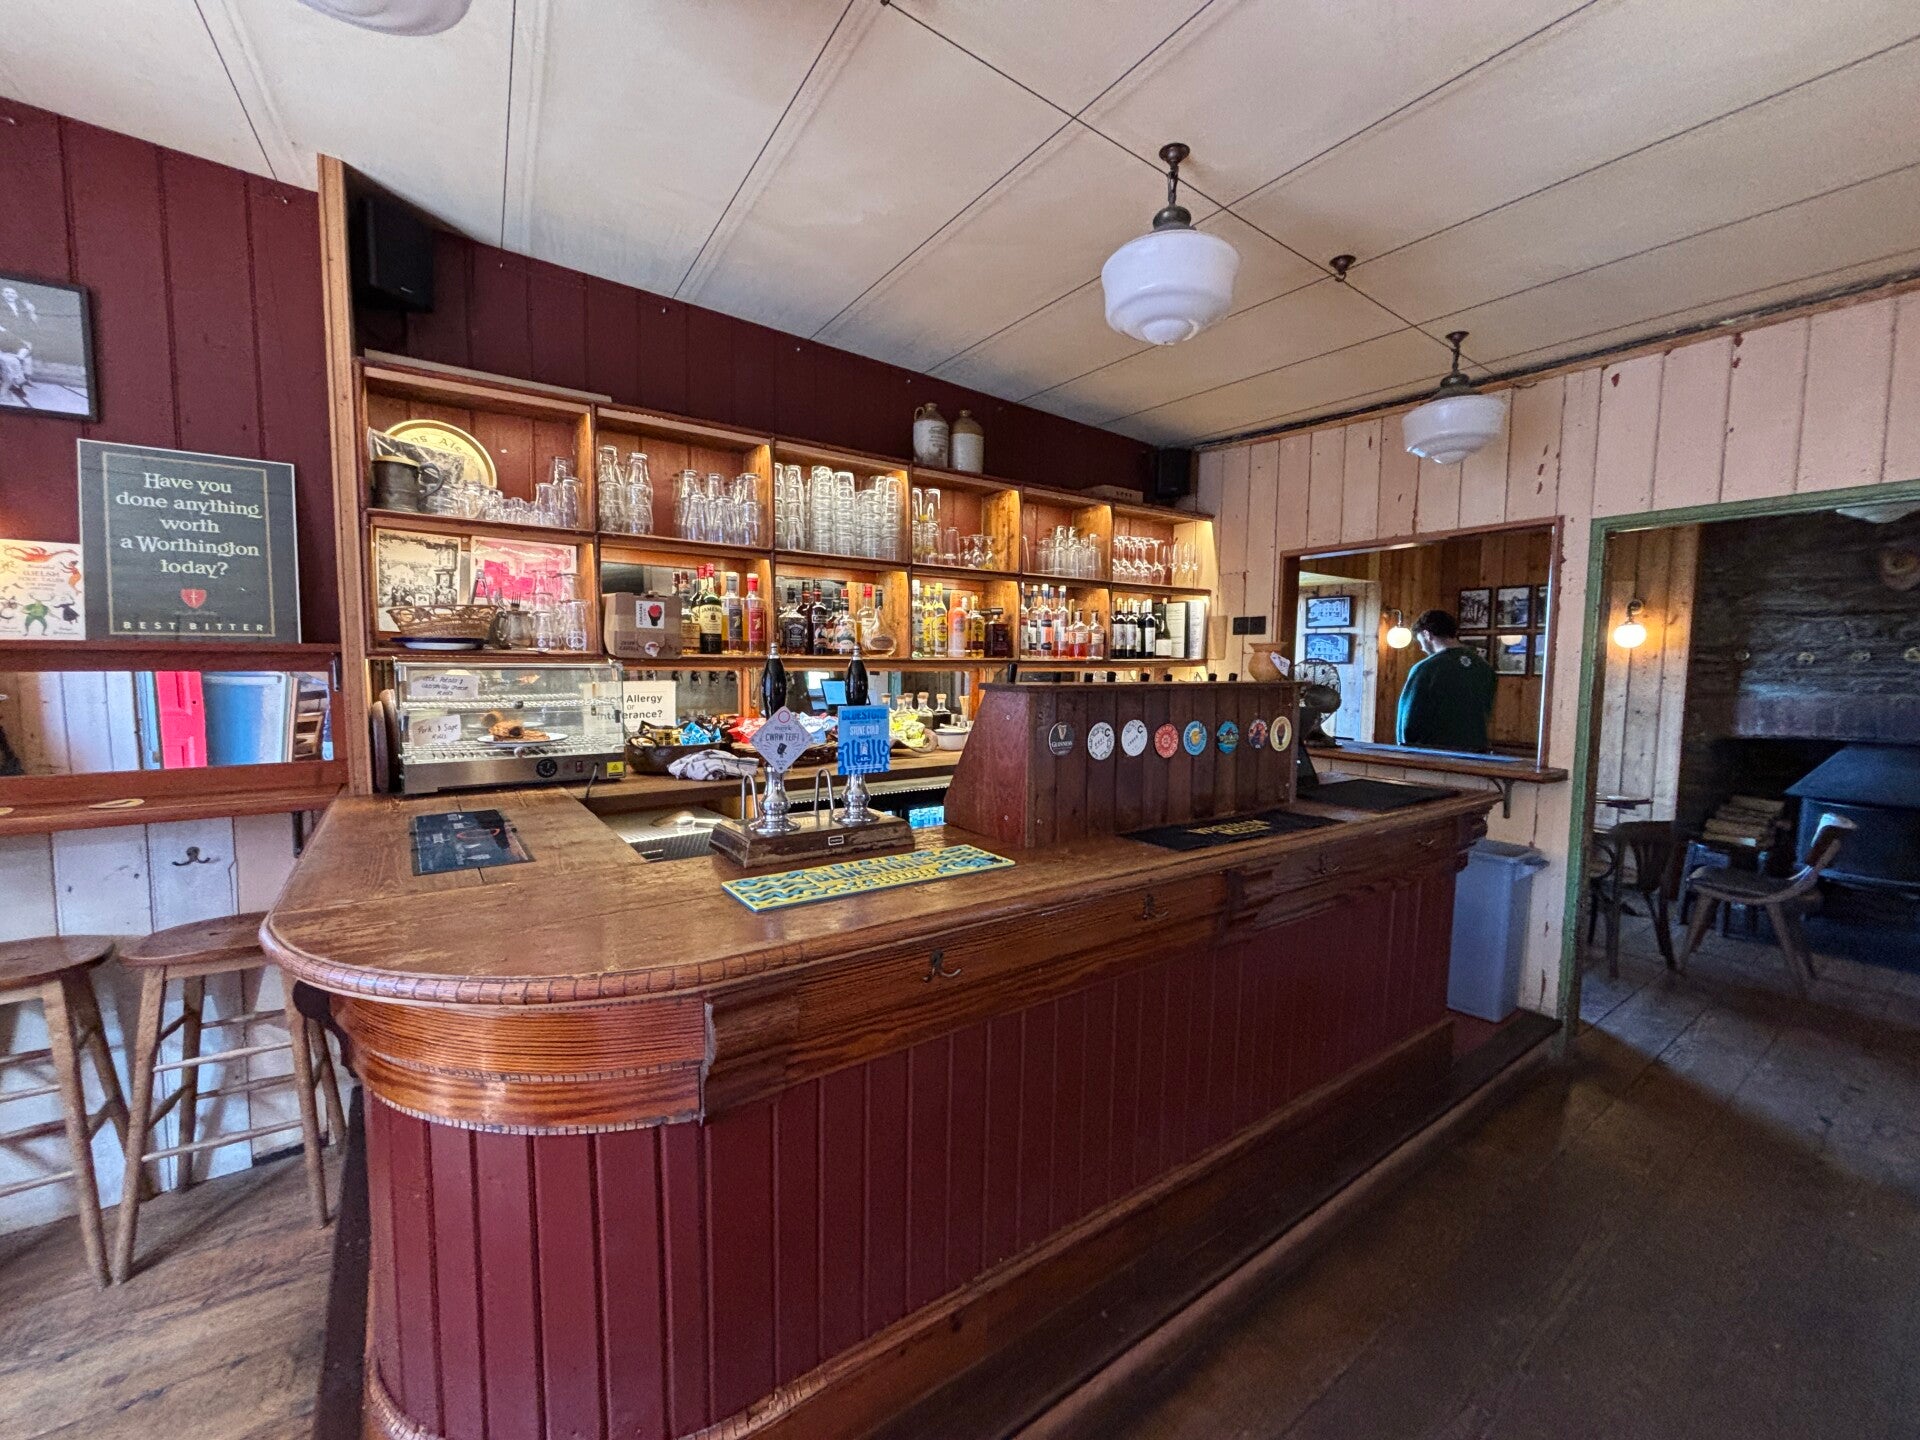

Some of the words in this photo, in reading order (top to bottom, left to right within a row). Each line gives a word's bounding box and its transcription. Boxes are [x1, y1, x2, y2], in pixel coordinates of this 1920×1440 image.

[143, 472, 194, 490] Have
[196, 480, 232, 496] you
[115, 491, 168, 508] done
[173, 498, 263, 519] anything
[159, 518, 220, 533] worth
[120, 537, 133, 549] a
[135, 535, 260, 557] Worthington
[160, 559, 229, 579] today?
[123, 621, 177, 631] BEST
[189, 622, 264, 632] BITTER
[626, 694, 663, 704] Allergy
[597, 710, 663, 721] Intoerance?
